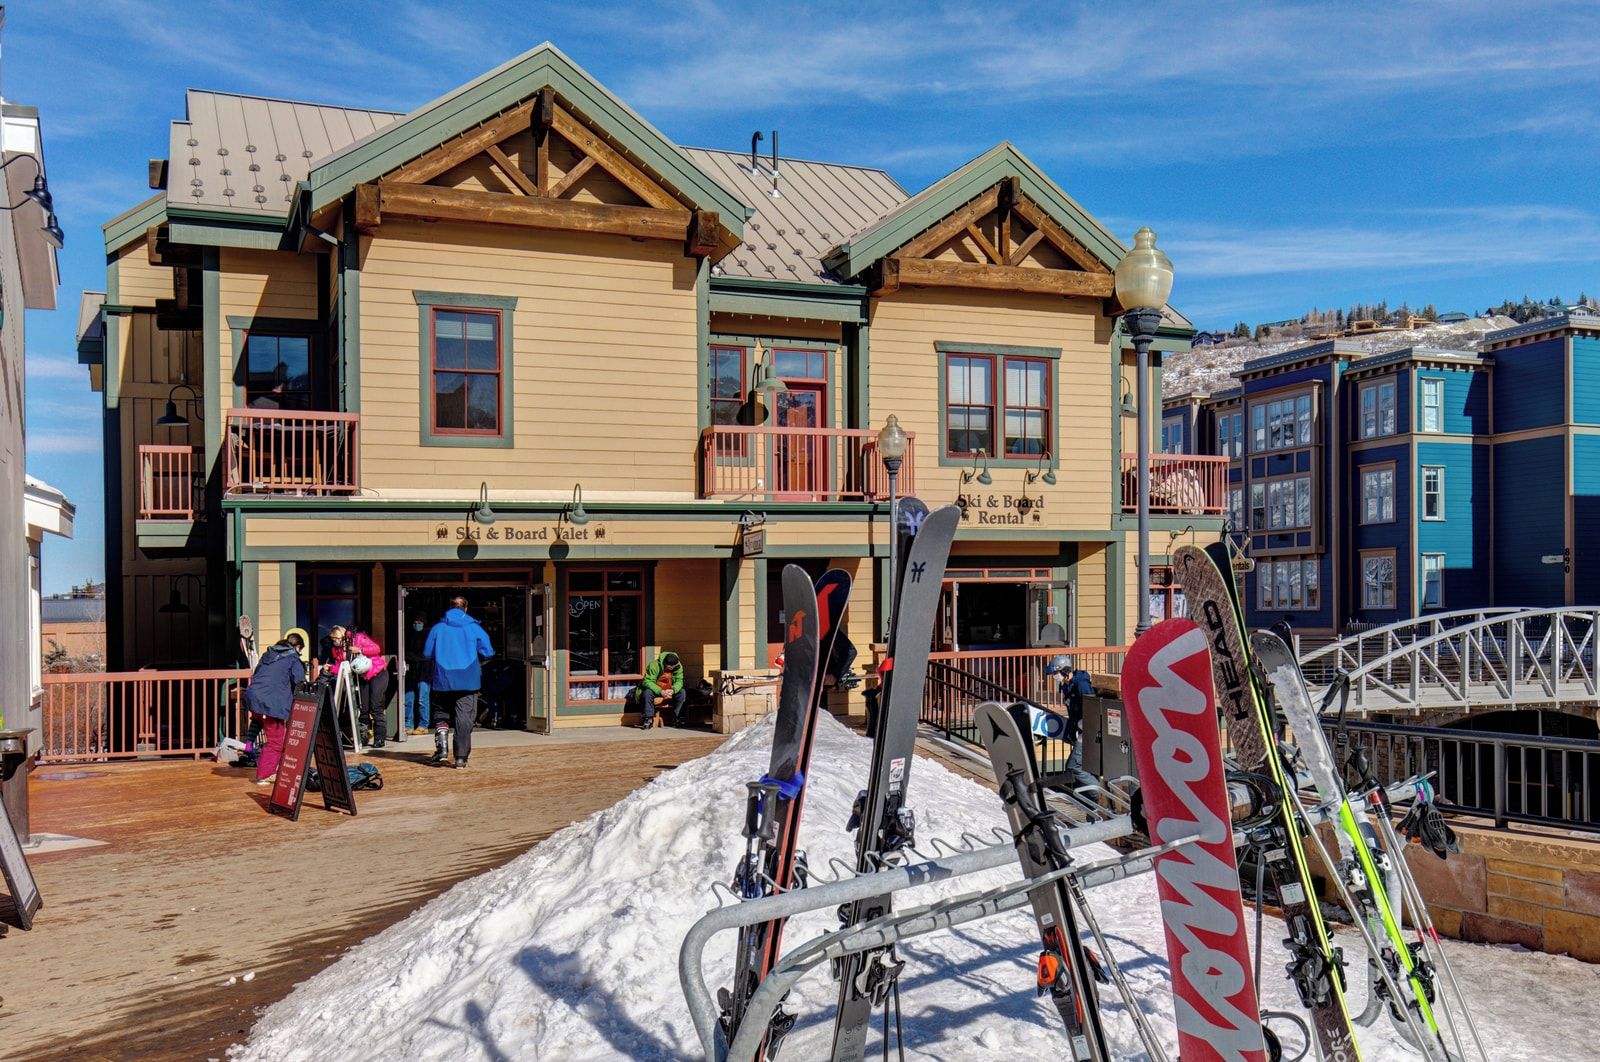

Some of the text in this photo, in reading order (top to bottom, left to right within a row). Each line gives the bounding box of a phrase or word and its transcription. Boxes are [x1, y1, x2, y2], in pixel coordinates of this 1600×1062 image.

[958, 494, 1044, 509] Ski & Board
[978, 511, 1024, 524] Rental
[456, 527, 588, 540] Ski & Board Valet
[1232, 561, 1250, 571] entals
[575, 600, 601, 611] OPEN
[1203, 599, 1249, 721] HEAD
